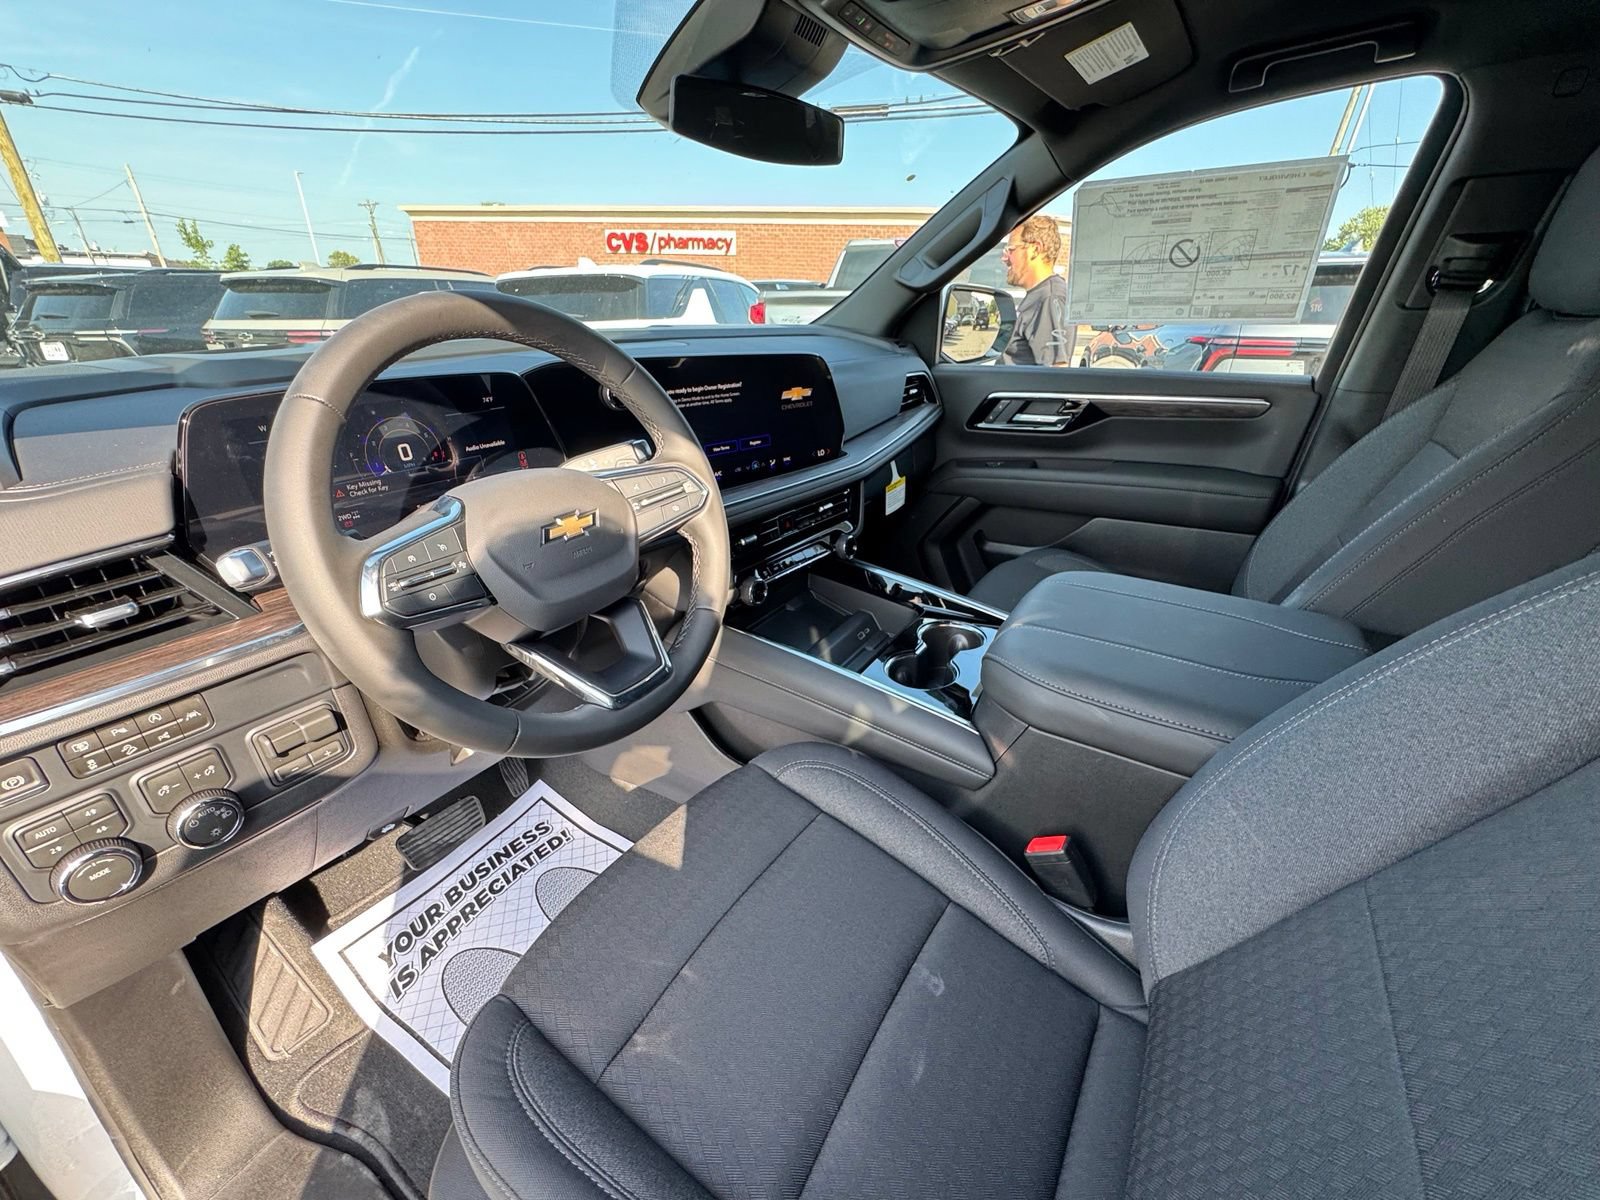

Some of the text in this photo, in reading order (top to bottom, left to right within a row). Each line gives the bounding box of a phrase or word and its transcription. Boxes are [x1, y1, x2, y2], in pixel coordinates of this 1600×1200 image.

[397, 443, 414, 462] 0
[817, 448, 825, 457] LO
[346, 479, 382, 492] Key Missing
[349, 489, 368, 498] Check
[377, 485, 389, 493] Key
[337, 513, 352, 522] 2WD
[197, 806, 216, 819] AUTO
[34, 826, 57, 840] AUTO
[88, 867, 112, 882] MODE
[378, 819, 552, 970] YOUR BUSINESS
[388, 829, 573, 1000] IS APPRECIATED!
